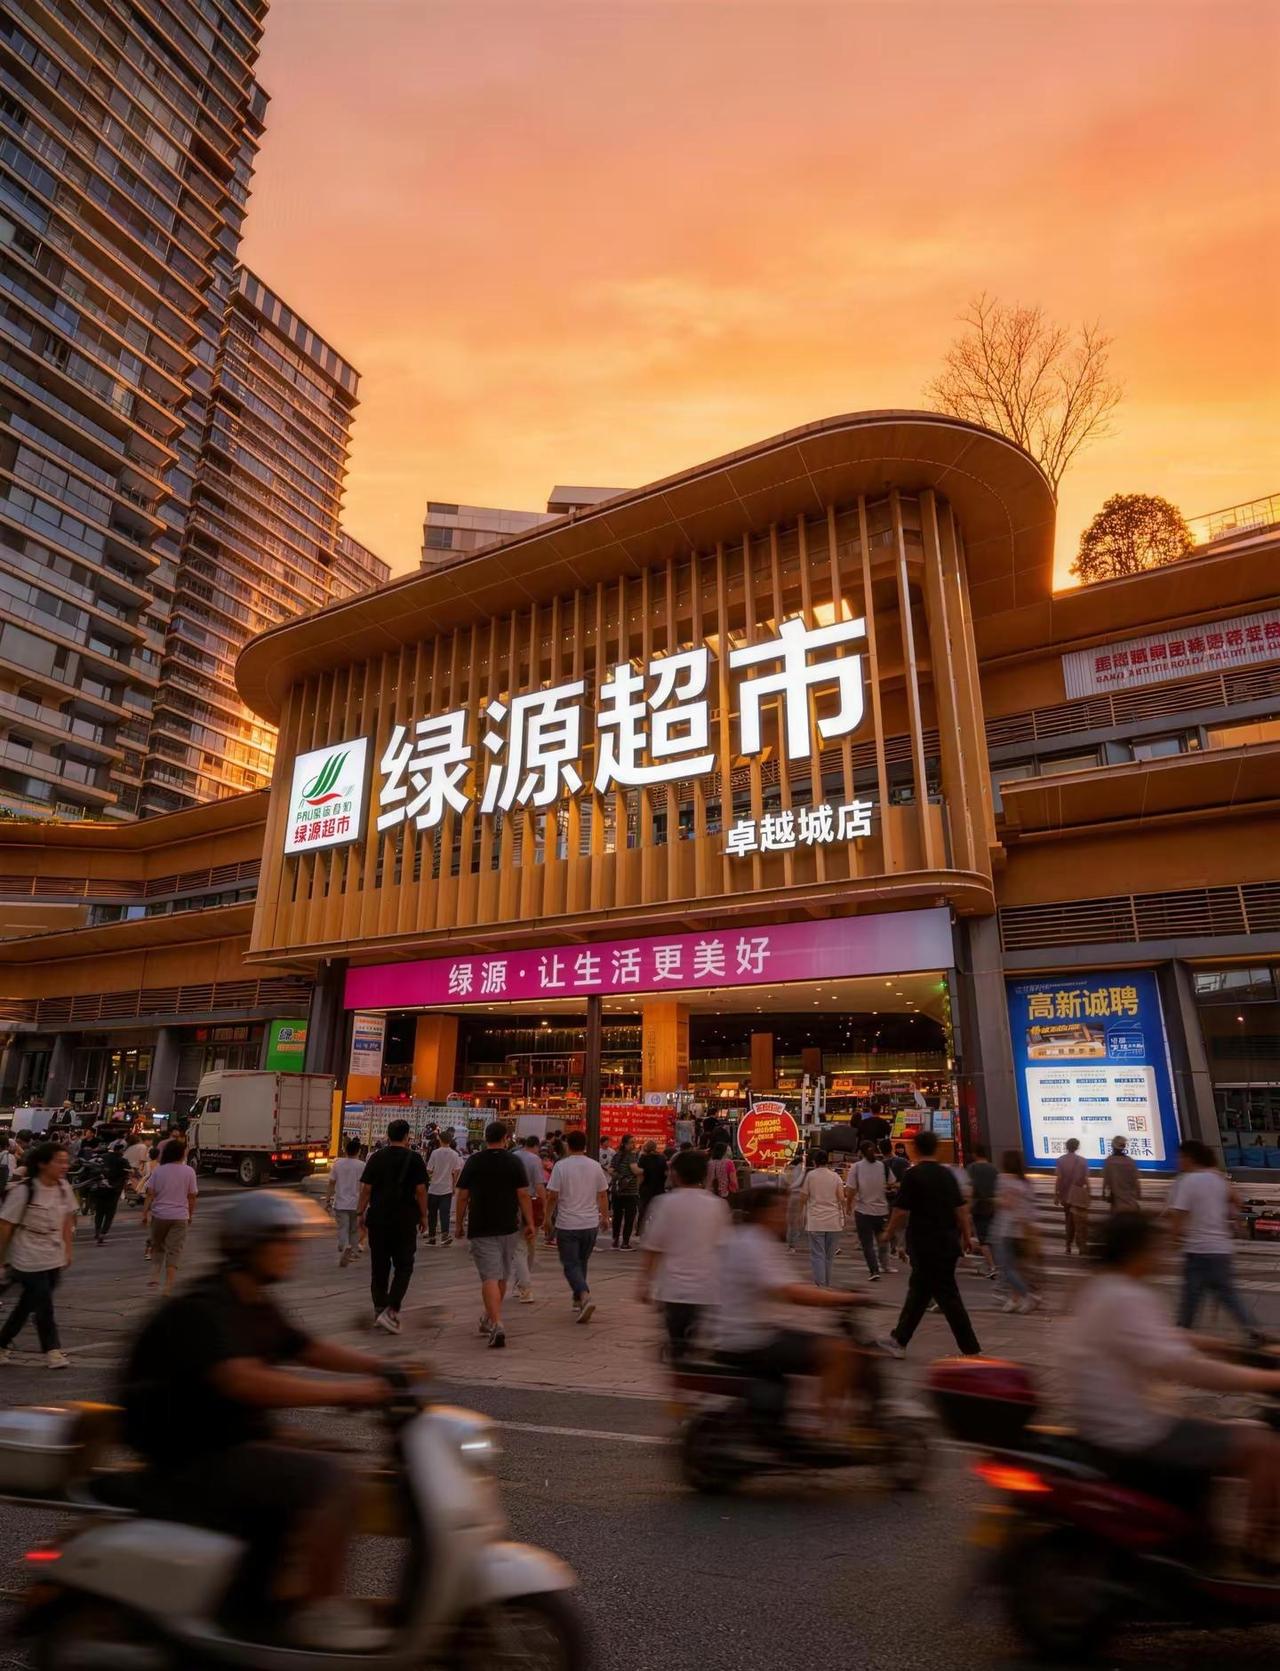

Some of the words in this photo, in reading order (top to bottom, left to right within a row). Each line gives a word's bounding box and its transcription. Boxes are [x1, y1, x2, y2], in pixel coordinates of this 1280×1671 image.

[377, 617, 866, 831] 绿源超市
[294, 816, 350, 844] 绿源超市
[725, 800, 873, 857] 卓越城店
[448, 936, 771, 995] 绿源·让生活更美好
[1027, 985, 1139, 1020] 高新诚聘
